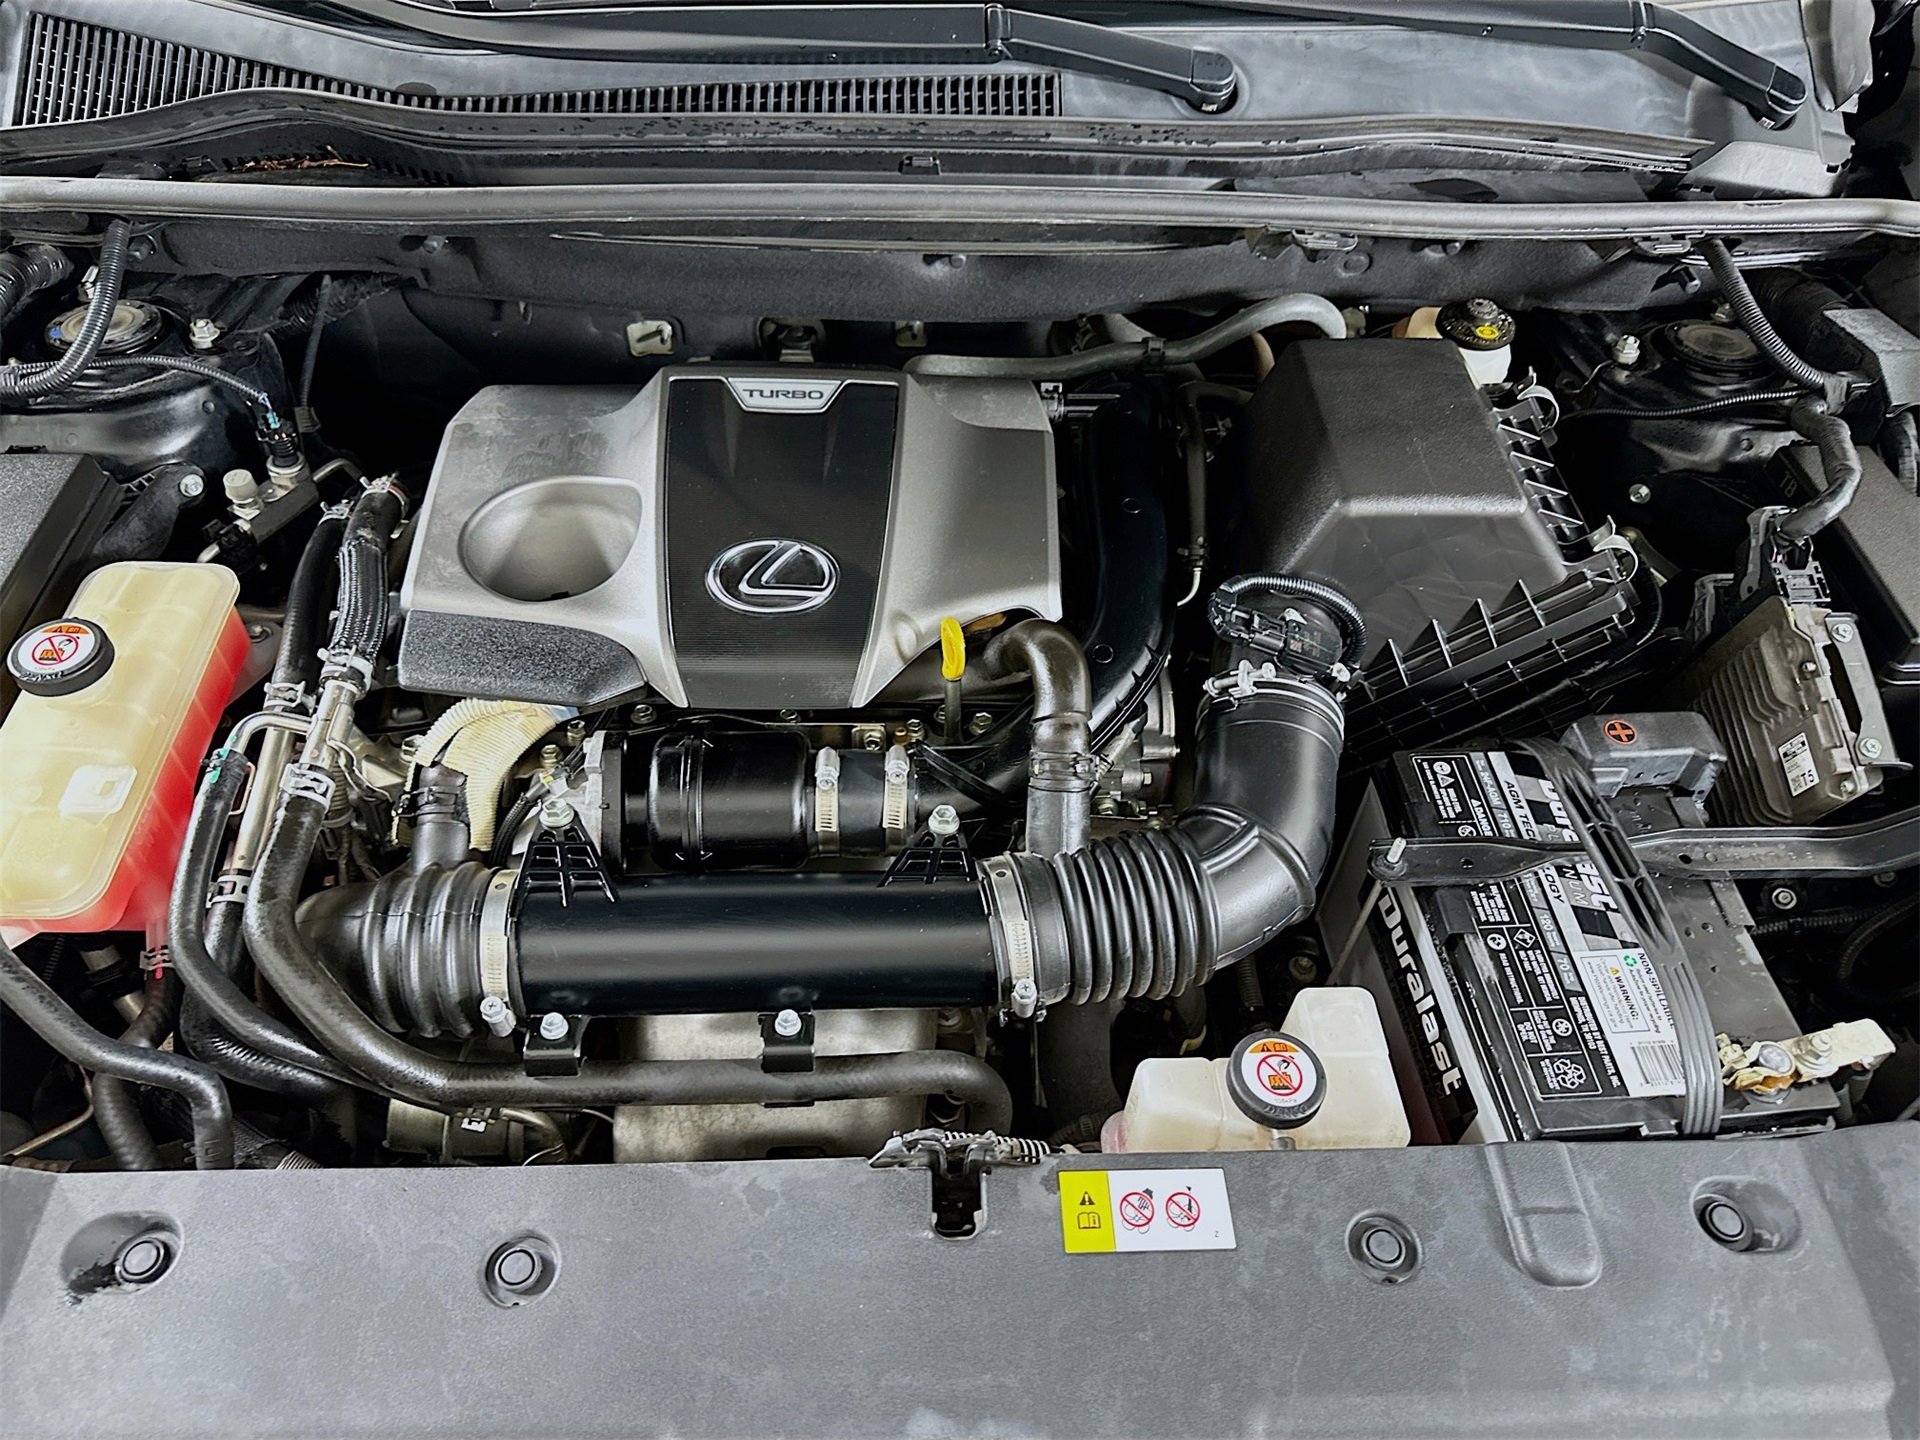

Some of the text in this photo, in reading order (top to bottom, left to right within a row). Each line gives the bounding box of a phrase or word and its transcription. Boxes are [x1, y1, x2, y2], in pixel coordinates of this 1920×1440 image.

[742, 388, 824, 400] TURBO
[1474, 807, 1492, 836] DANGE
[1497, 813, 1511, 828] 710
[1504, 780, 1524, 809] AGM
[1518, 814, 1564, 903] TECOGY
[1538, 779, 1613, 908] Duraast
[1542, 824, 1589, 904] PLNUM
[1539, 915, 1553, 930] 120
[1557, 958, 1570, 970] 70
[1378, 894, 1463, 1096] Duralast
[1615, 976, 1638, 1019] WARNING:
[1578, 996, 1597, 1030] DISTRIBUTED
[1595, 1040, 1608, 1054] BEST
[1602, 1055, 1615, 1074] PARTS,
